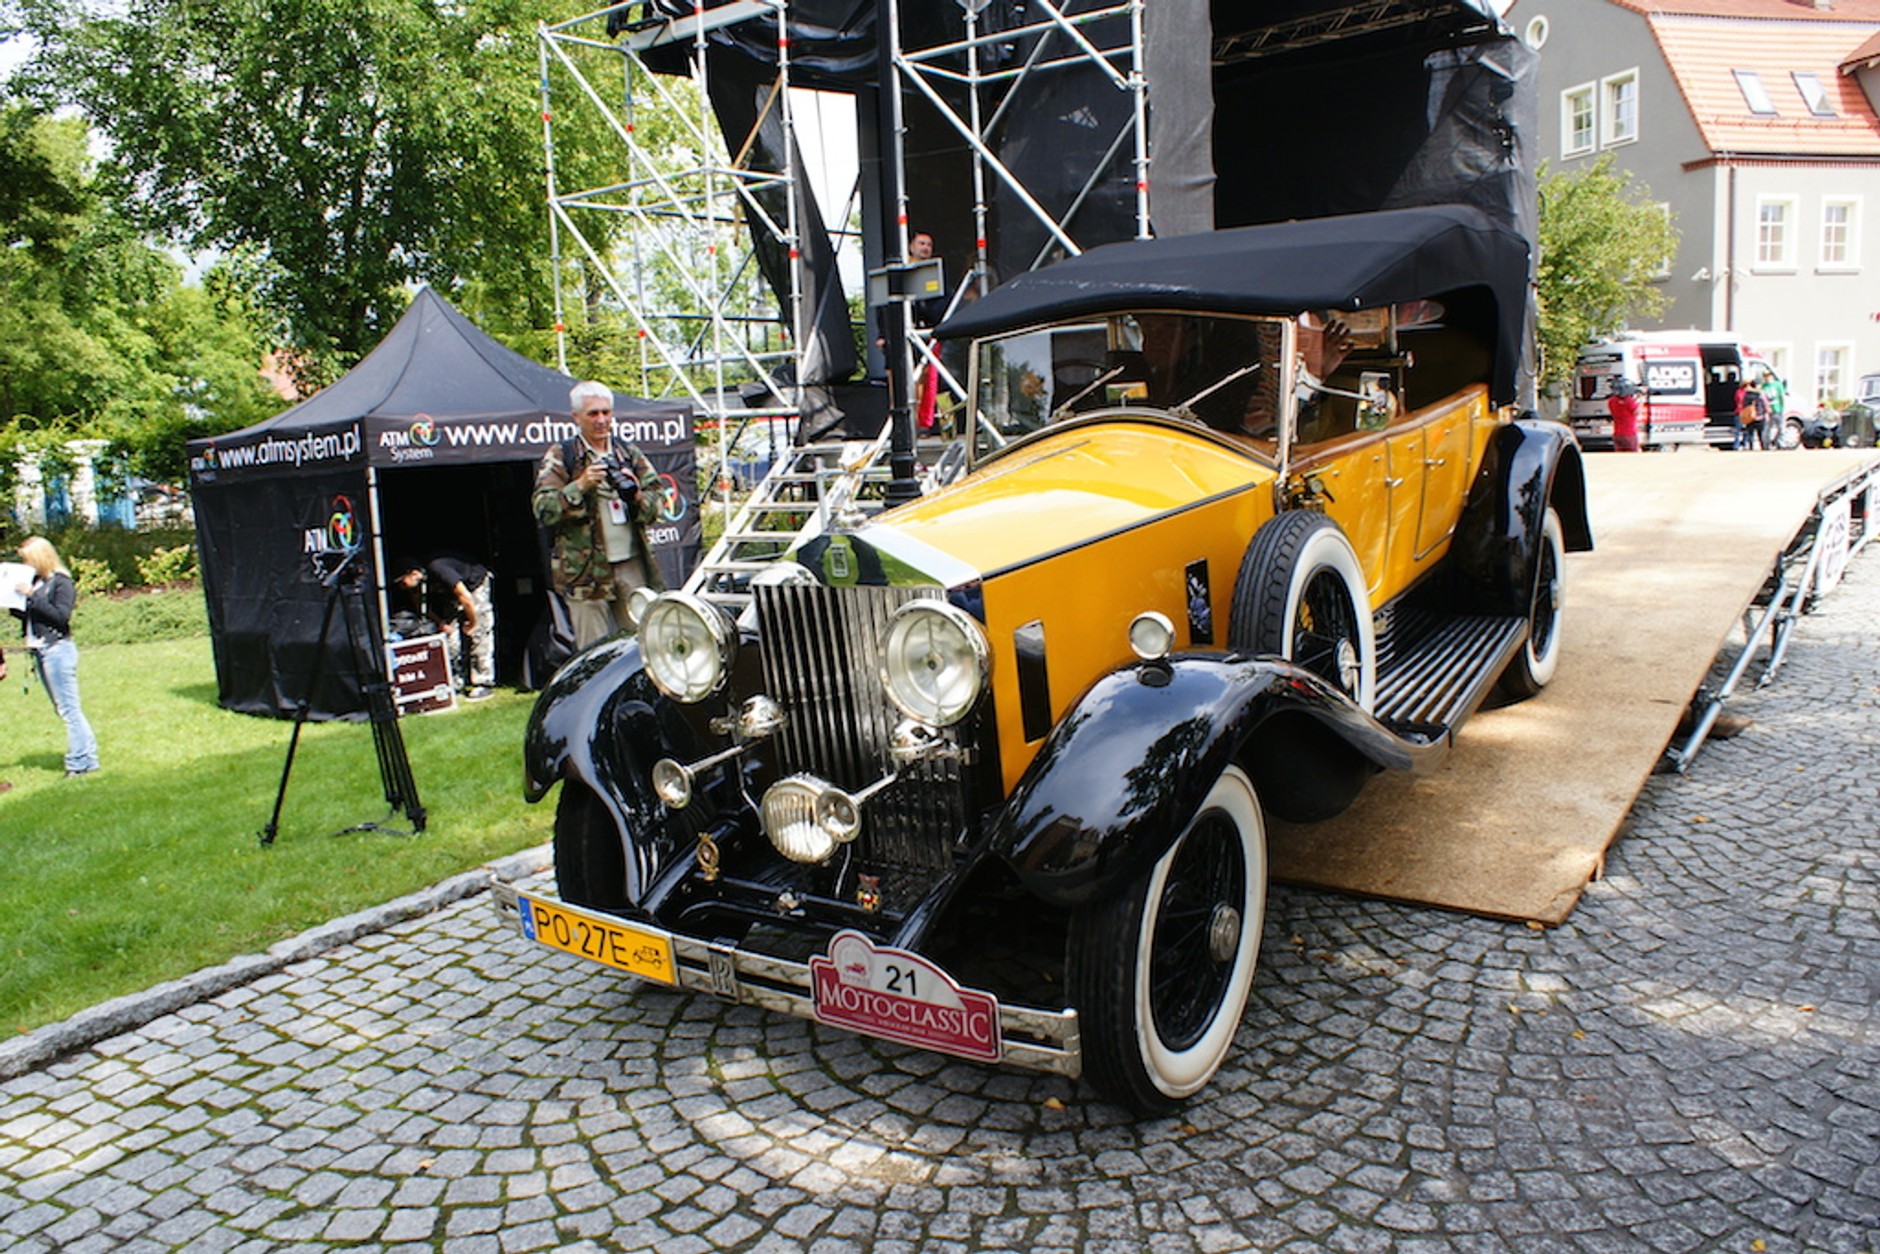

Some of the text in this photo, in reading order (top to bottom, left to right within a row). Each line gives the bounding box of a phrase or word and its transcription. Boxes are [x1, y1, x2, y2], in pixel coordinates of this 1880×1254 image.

[219, 424, 361, 467] www.atmsystem.pl
[380, 431, 410, 447] ATM
[444, 414, 686, 446] www.atmtem.pl
[390, 447, 434, 464] System
[534, 906, 630, 967] PO 27E
[885, 964, 917, 997] 21
[821, 979, 989, 1043] MOTOCLASSIC
